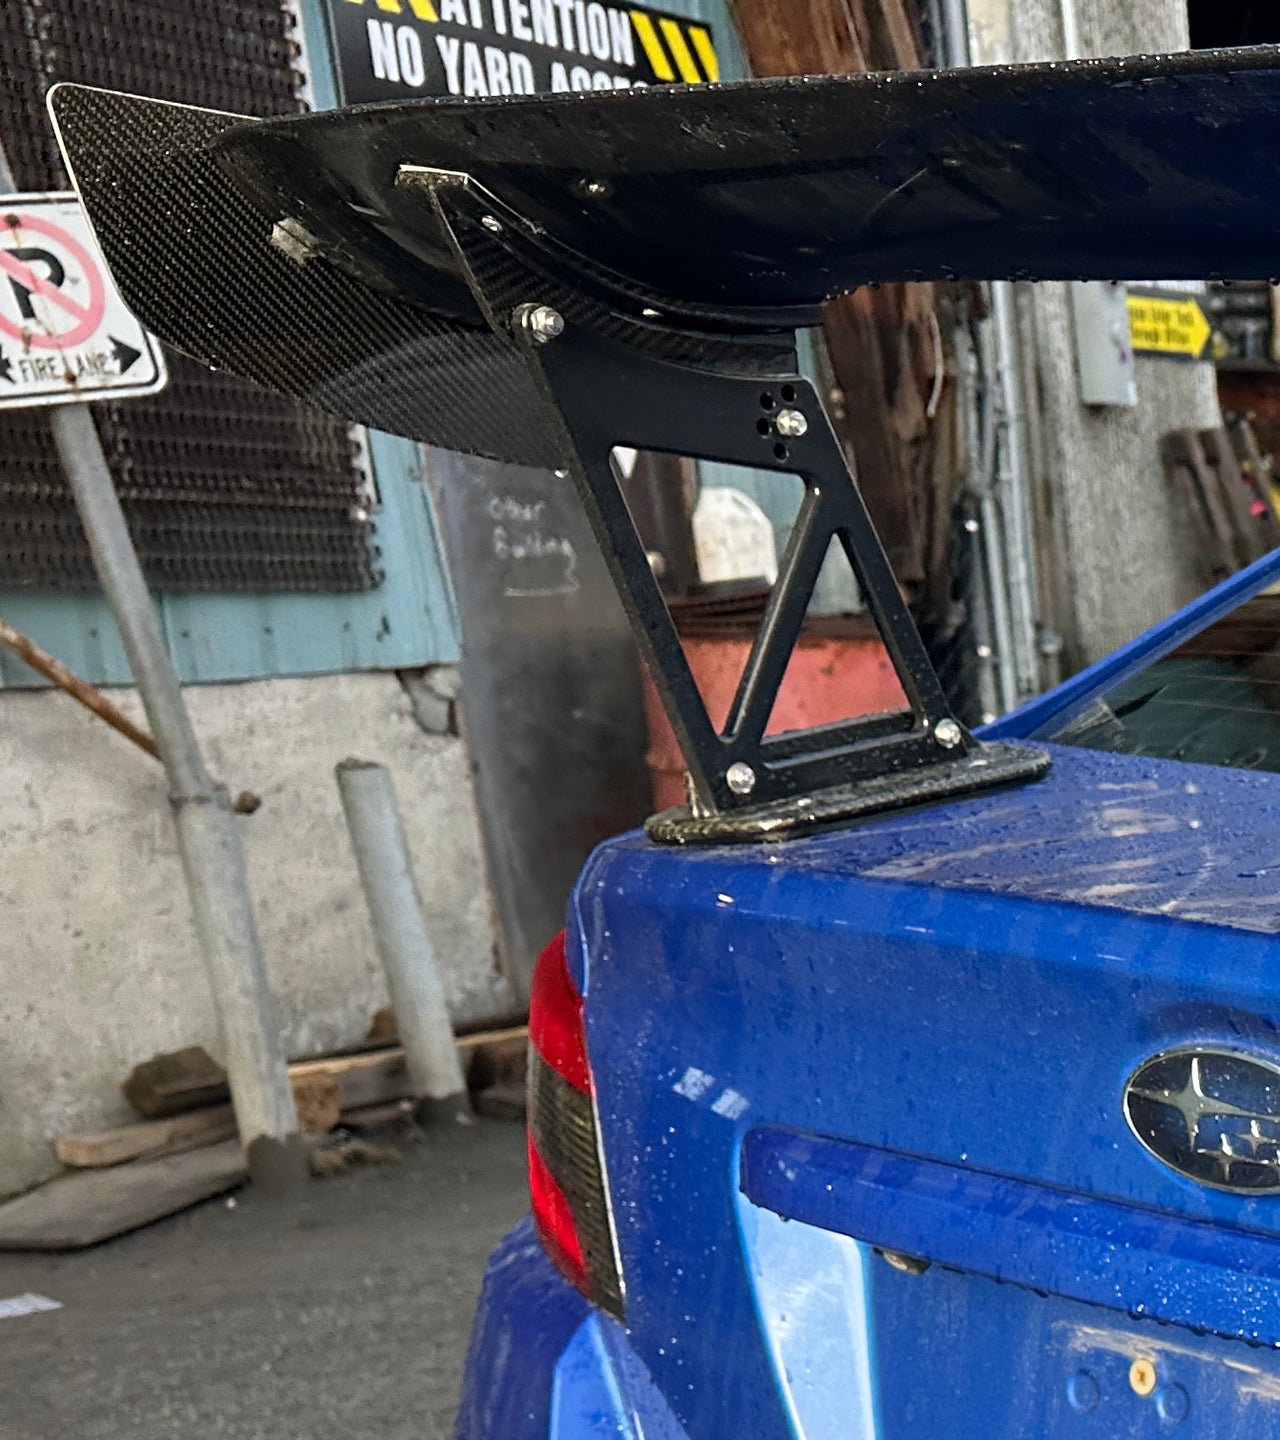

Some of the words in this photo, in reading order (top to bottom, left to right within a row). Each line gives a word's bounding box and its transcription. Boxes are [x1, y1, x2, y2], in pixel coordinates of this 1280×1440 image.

[367, 18, 425, 88] NO
[434, 34, 536, 97] YARD
[18, 357, 62, 383] FIRE
